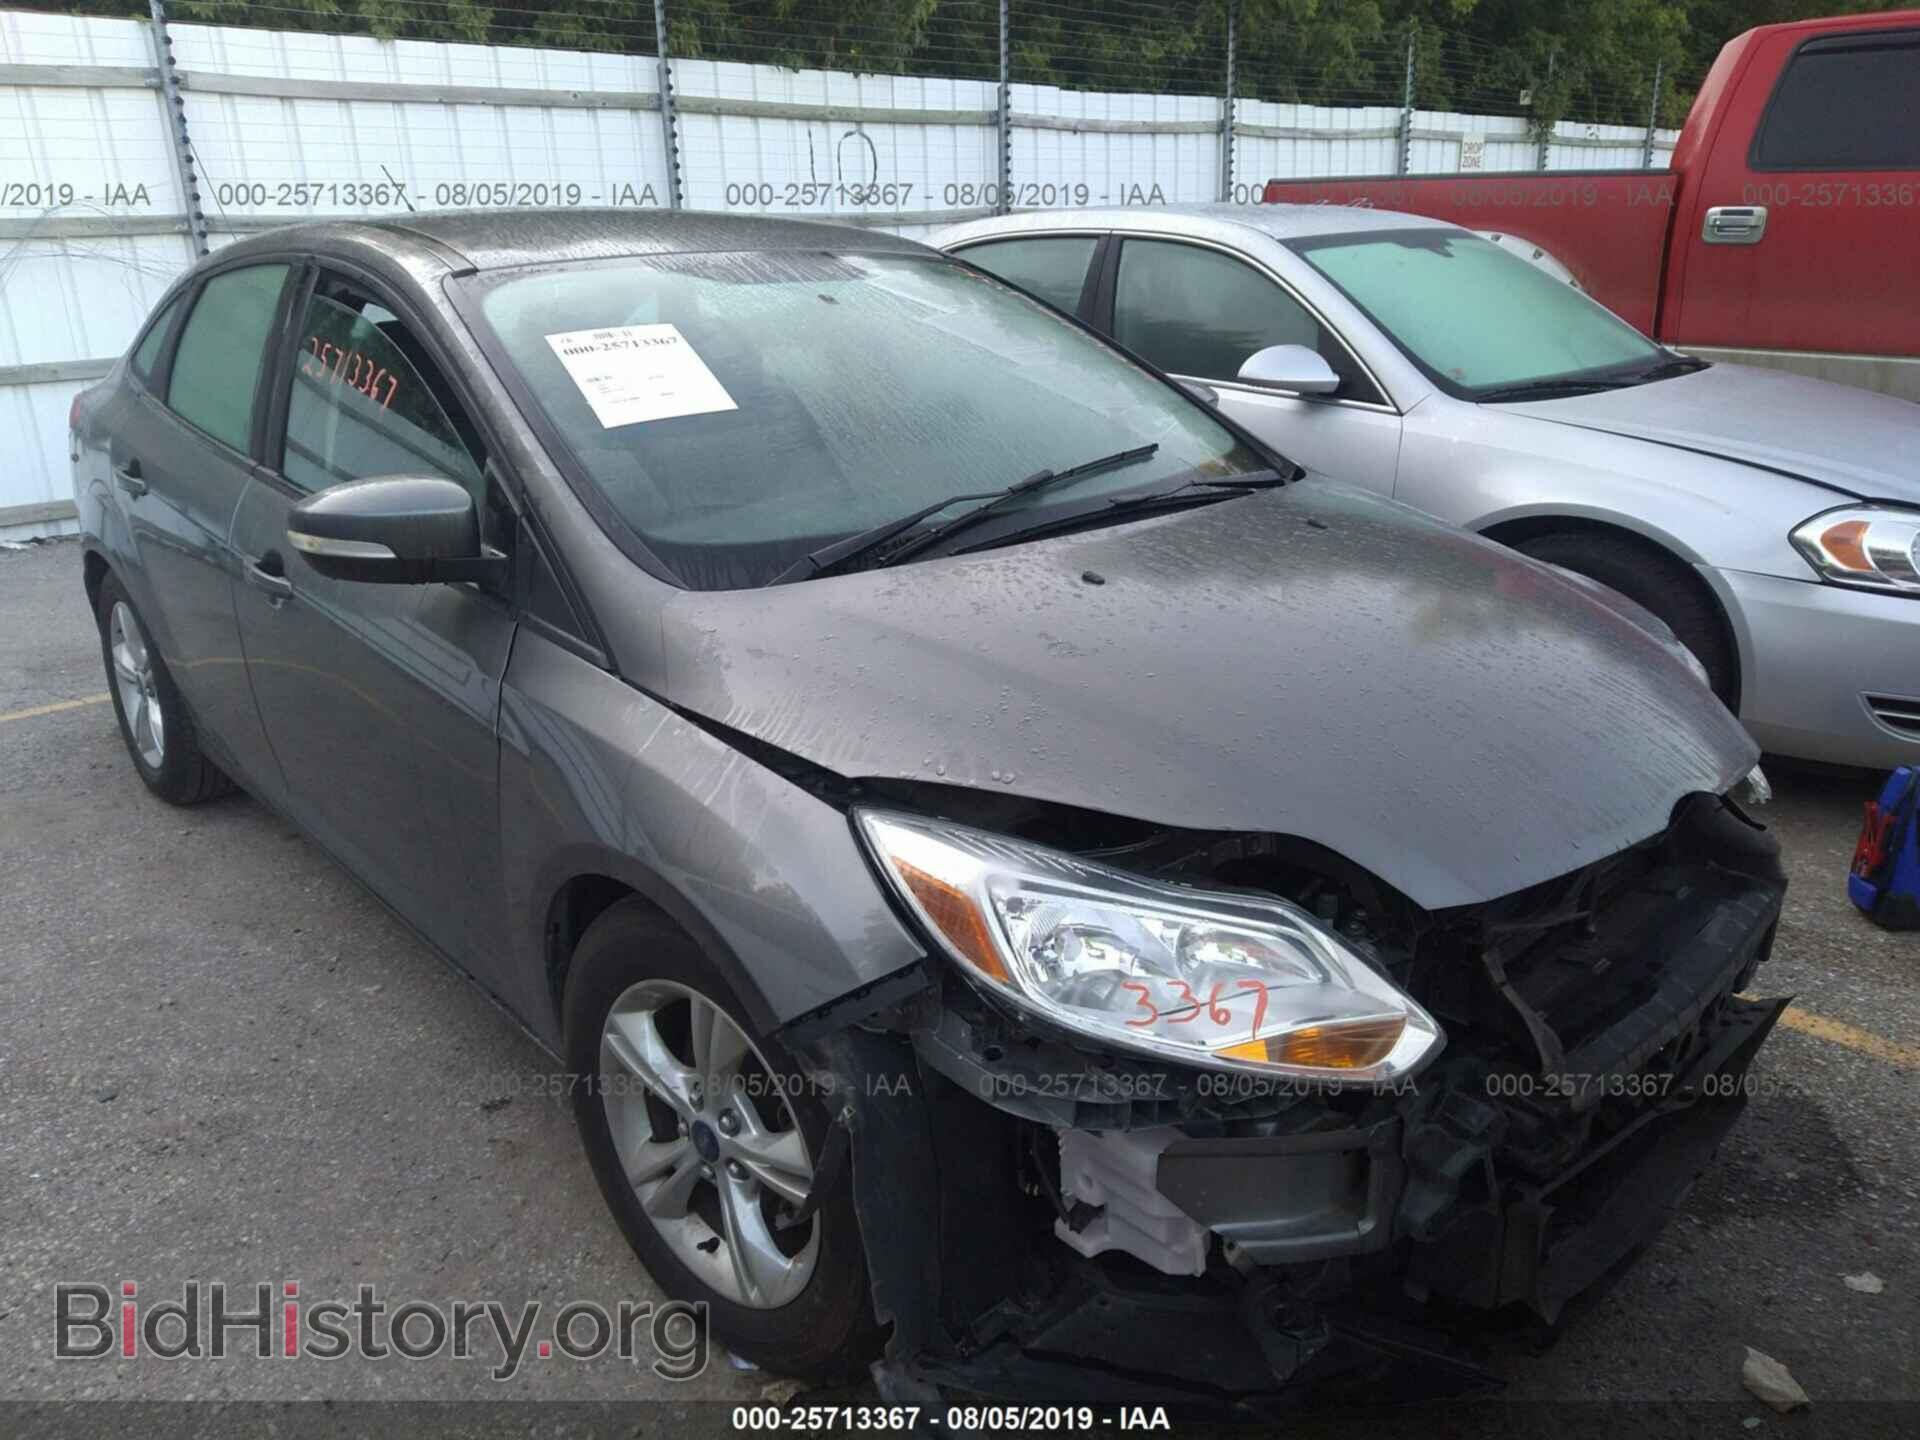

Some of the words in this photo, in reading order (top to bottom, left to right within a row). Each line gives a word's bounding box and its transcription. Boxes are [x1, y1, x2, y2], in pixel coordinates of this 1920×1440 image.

[302, 336, 398, 416] 25713367
[563, 336, 678, 357] 000-25713367
[1121, 978, 1268, 1041] 3367
